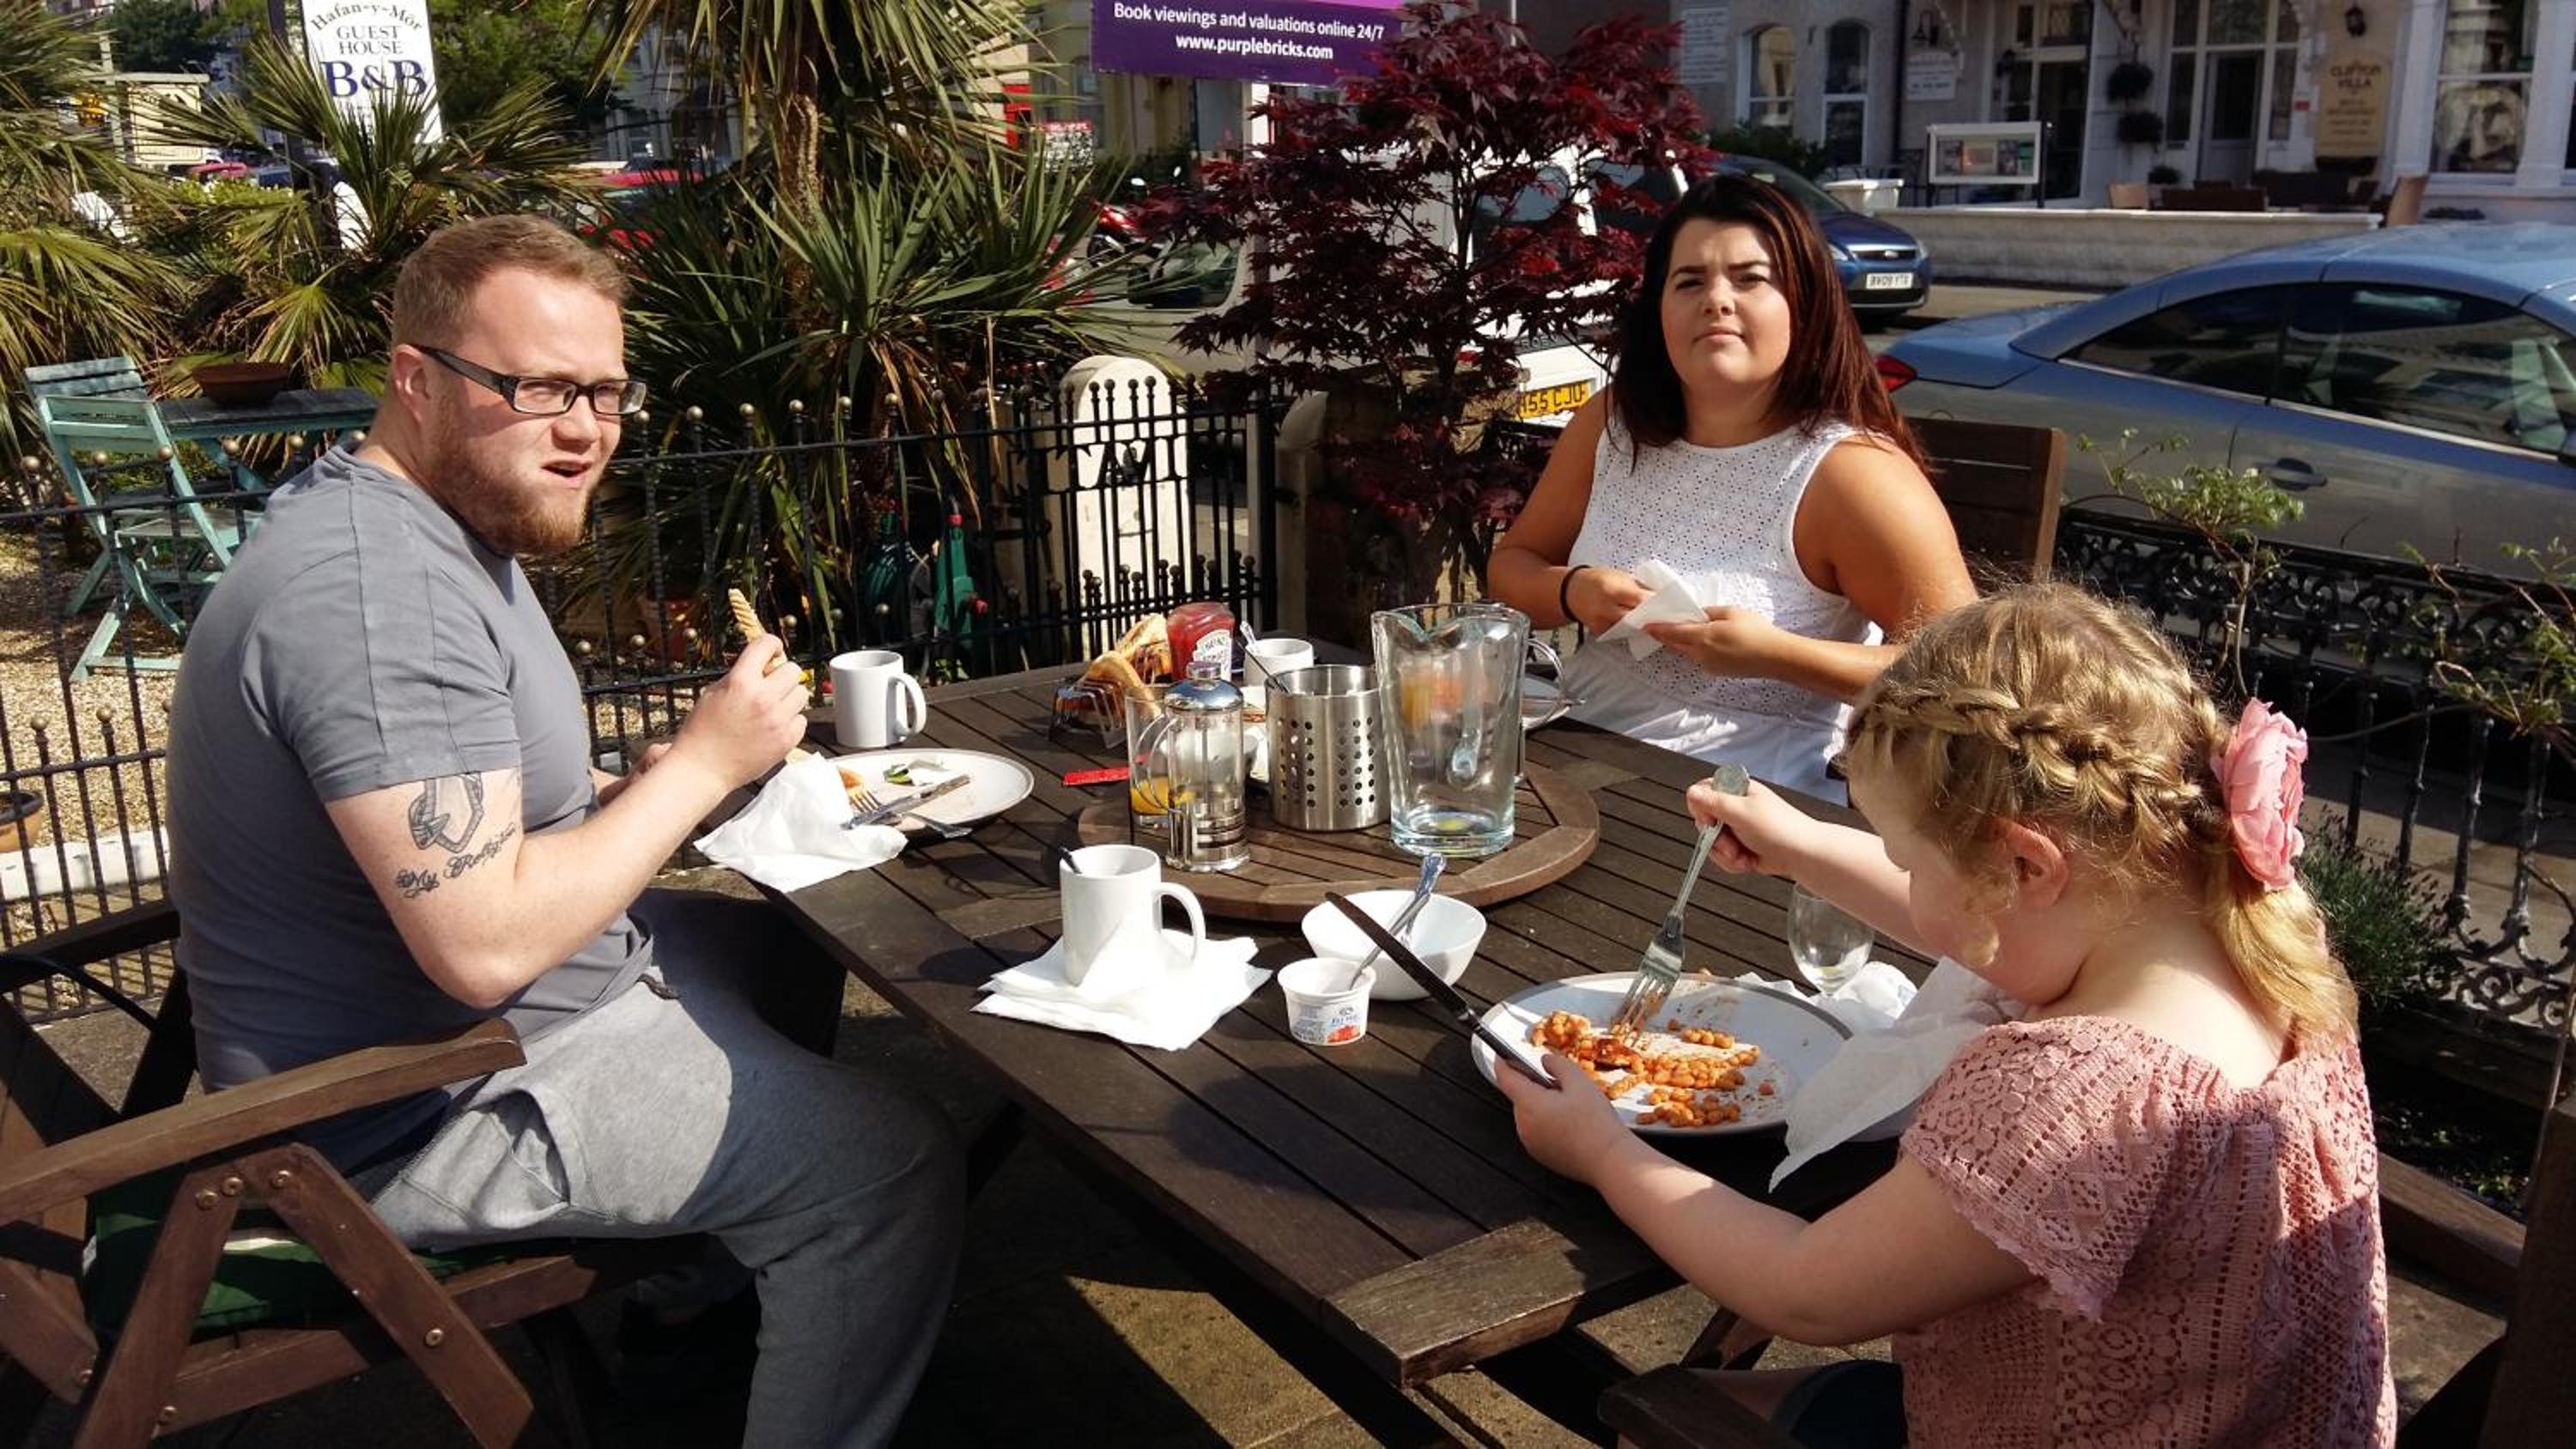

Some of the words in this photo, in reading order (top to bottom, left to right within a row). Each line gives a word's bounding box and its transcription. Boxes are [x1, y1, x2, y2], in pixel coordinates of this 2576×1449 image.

[336, 25, 401, 40] GUEST
[1114, 3, 1151, 20] Book
[1154, 6, 1217, 28] viewings
[1219, 12, 1246, 27] and
[1249, 14, 1315, 33] valuations
[1317, 21, 1356, 38] online
[1357, 24, 1384, 41] 24/7
[338, 40, 404, 55] HOUSE
[1176, 35, 1334, 59] www.purplebricks.com
[319, 60, 428, 97] B&B
